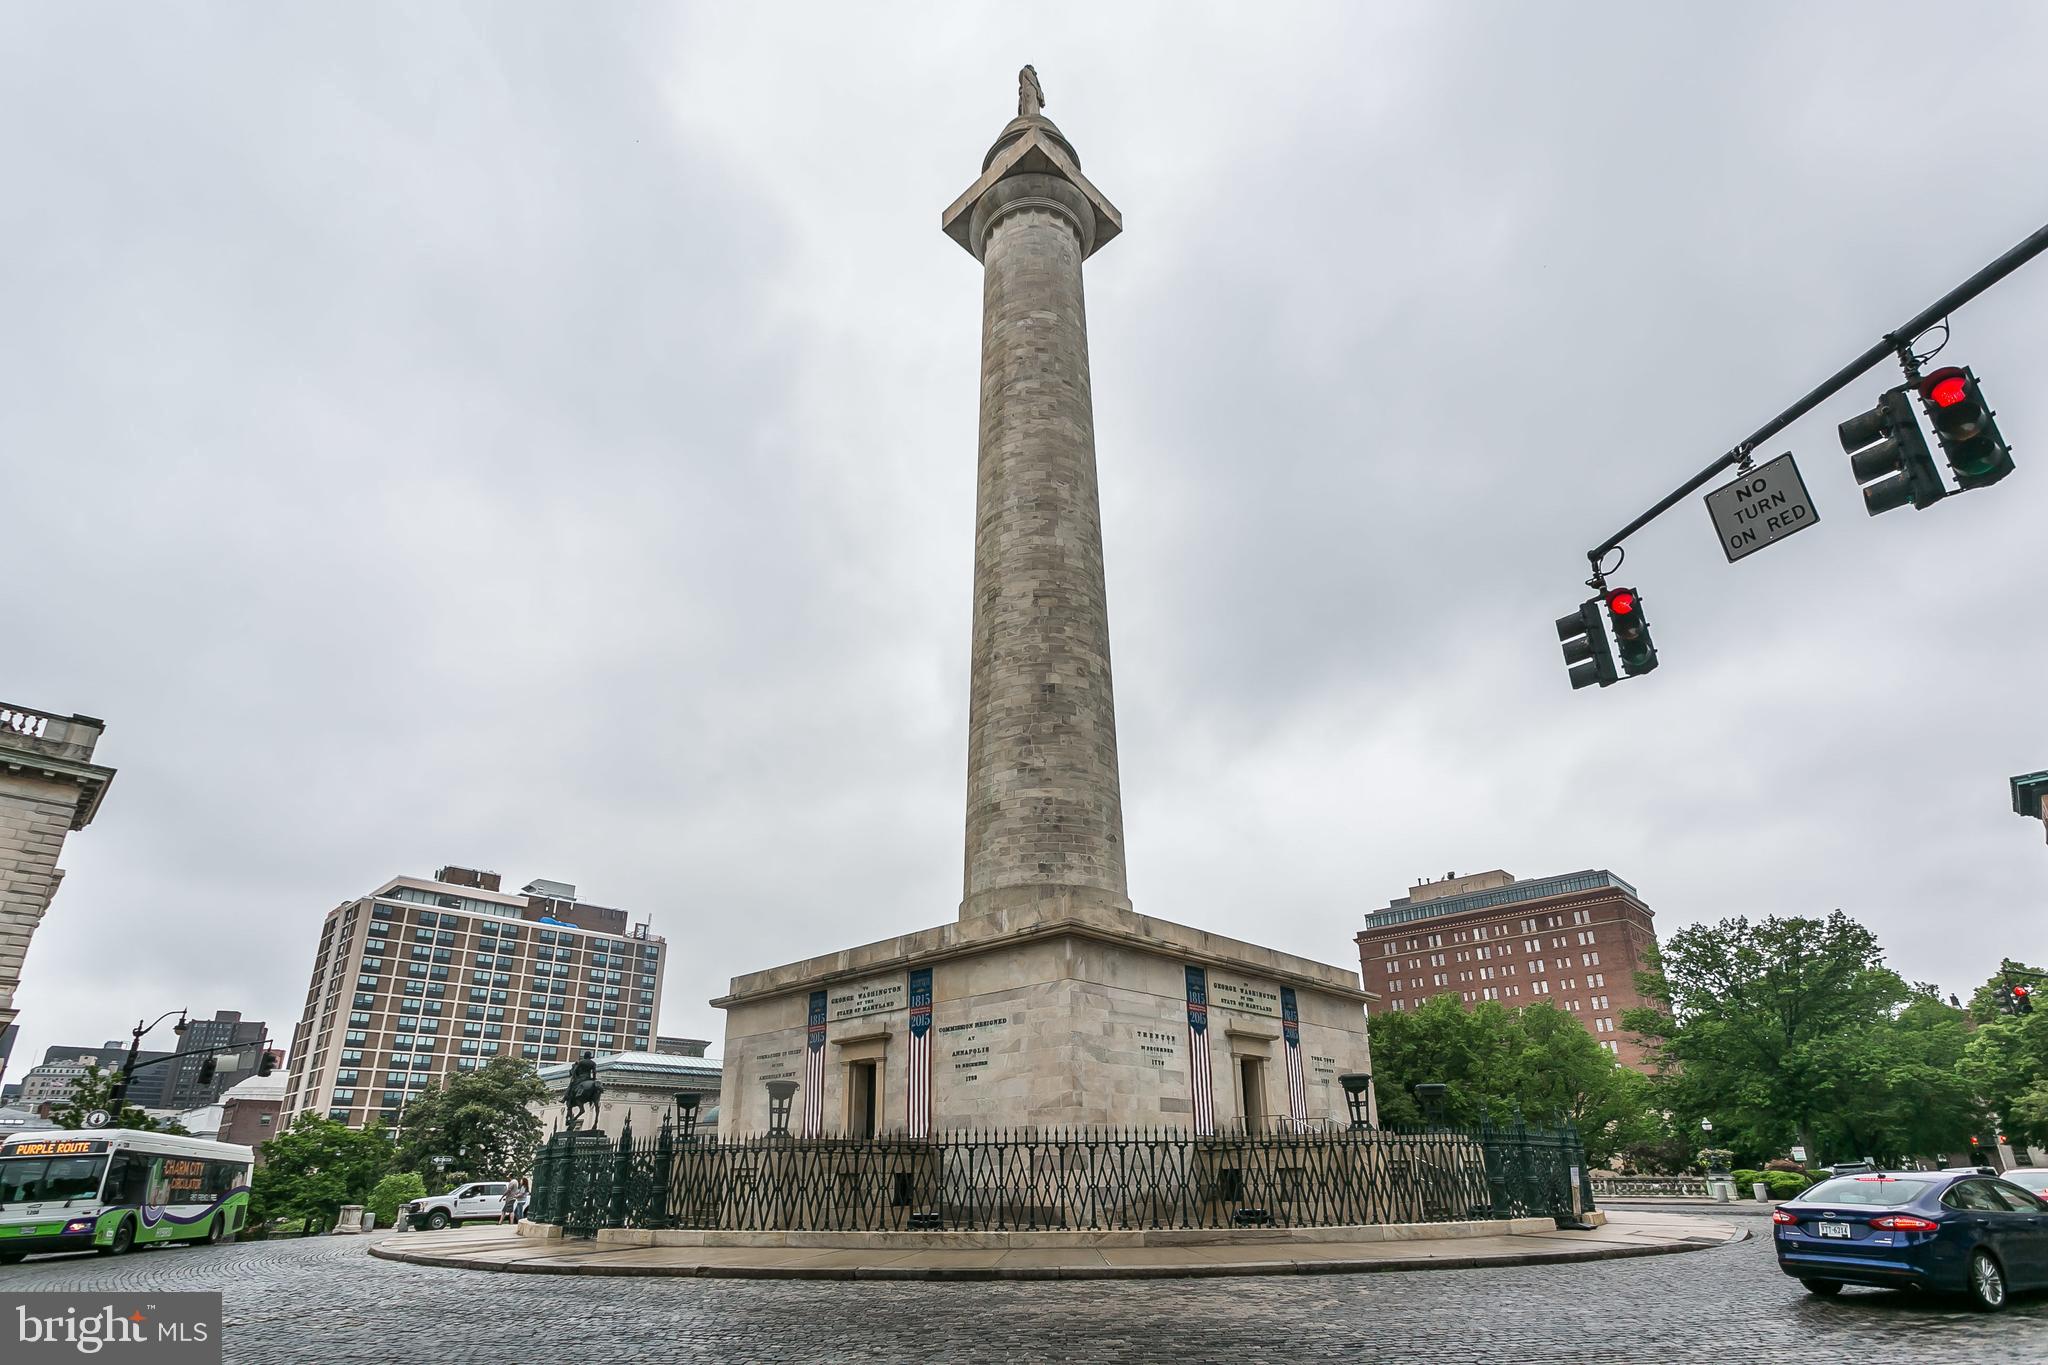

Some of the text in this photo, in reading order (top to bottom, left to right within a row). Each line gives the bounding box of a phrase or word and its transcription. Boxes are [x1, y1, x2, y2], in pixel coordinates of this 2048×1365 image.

[1736, 478, 1766, 502] NO
[1734, 490, 1786, 524] TURN
[1731, 505, 1805, 549] ON RED
[831, 985, 902, 1004] GEORGE WASHINGTON
[1189, 991, 1205, 1004] 1815
[1213, 982, 1277, 1000] GEORGE WASHINGTON
[862, 1001, 894, 1012] MARYLAND
[911, 993, 930, 1007] 1815
[810, 1013, 825, 1026] 1815
[911, 1013, 930, 1027] 2015
[1190, 1011, 1206, 1024] 2015
[809, 1031, 824, 1043] 2015
[1137, 1031, 1175, 1041] TRENTON
[952, 1047, 989, 1057] ANNAPOLIS
[16, 1142, 91, 1154] PURPLE ROUTE
[164, 1160, 205, 1176] CHARM CITY
